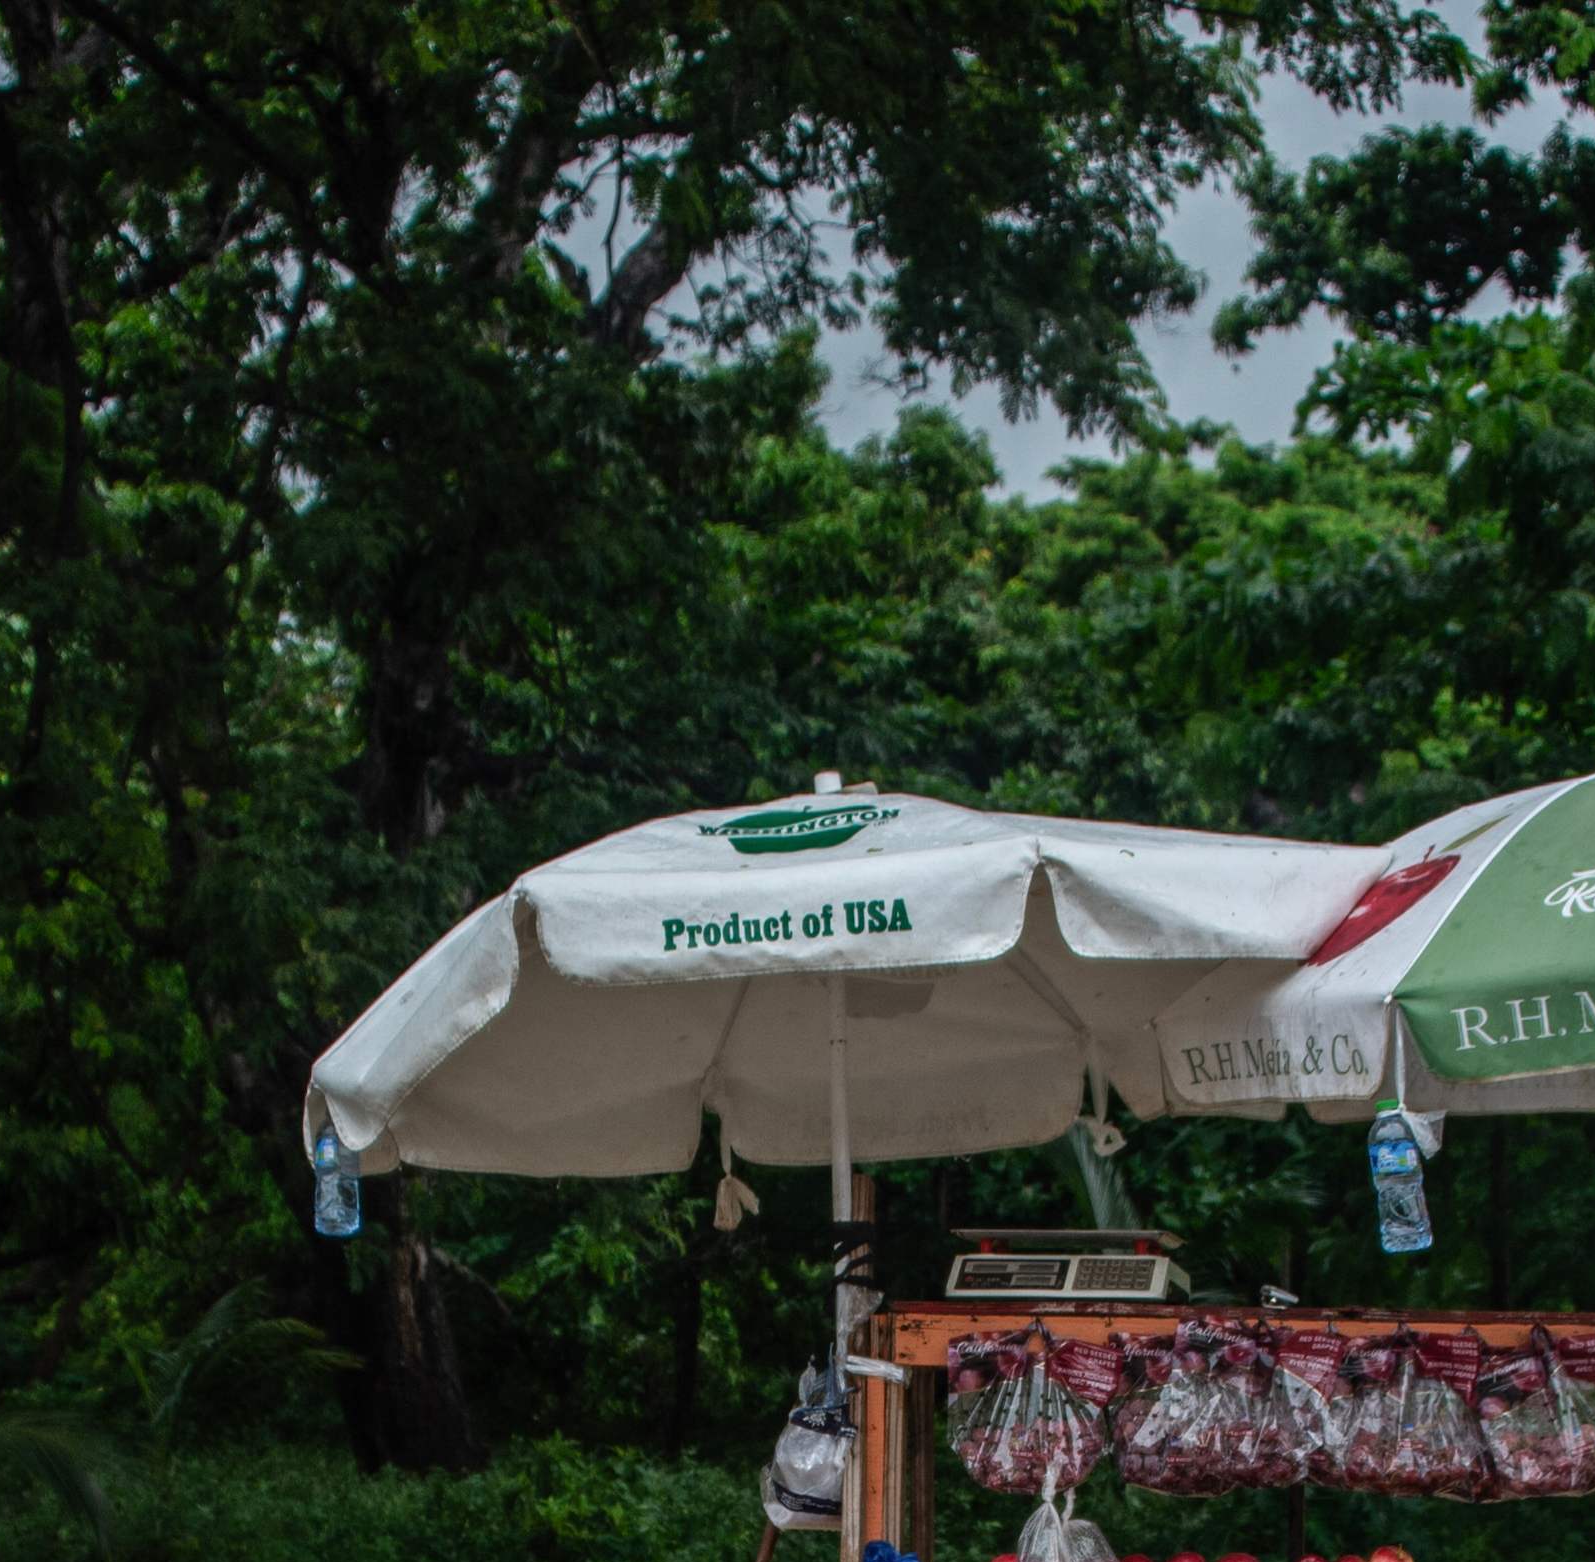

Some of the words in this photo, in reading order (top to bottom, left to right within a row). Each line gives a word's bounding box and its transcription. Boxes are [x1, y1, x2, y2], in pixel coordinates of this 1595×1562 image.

[696, 808, 901, 836] WASHINGTON
[662, 910, 793, 951] Product
[802, 904, 834, 938] of
[844, 898, 912, 935] USA
[1450, 996, 1568, 1051] R.H.
[1302, 1035, 1323, 1075] &
[1332, 1034, 1369, 1075] Co.
